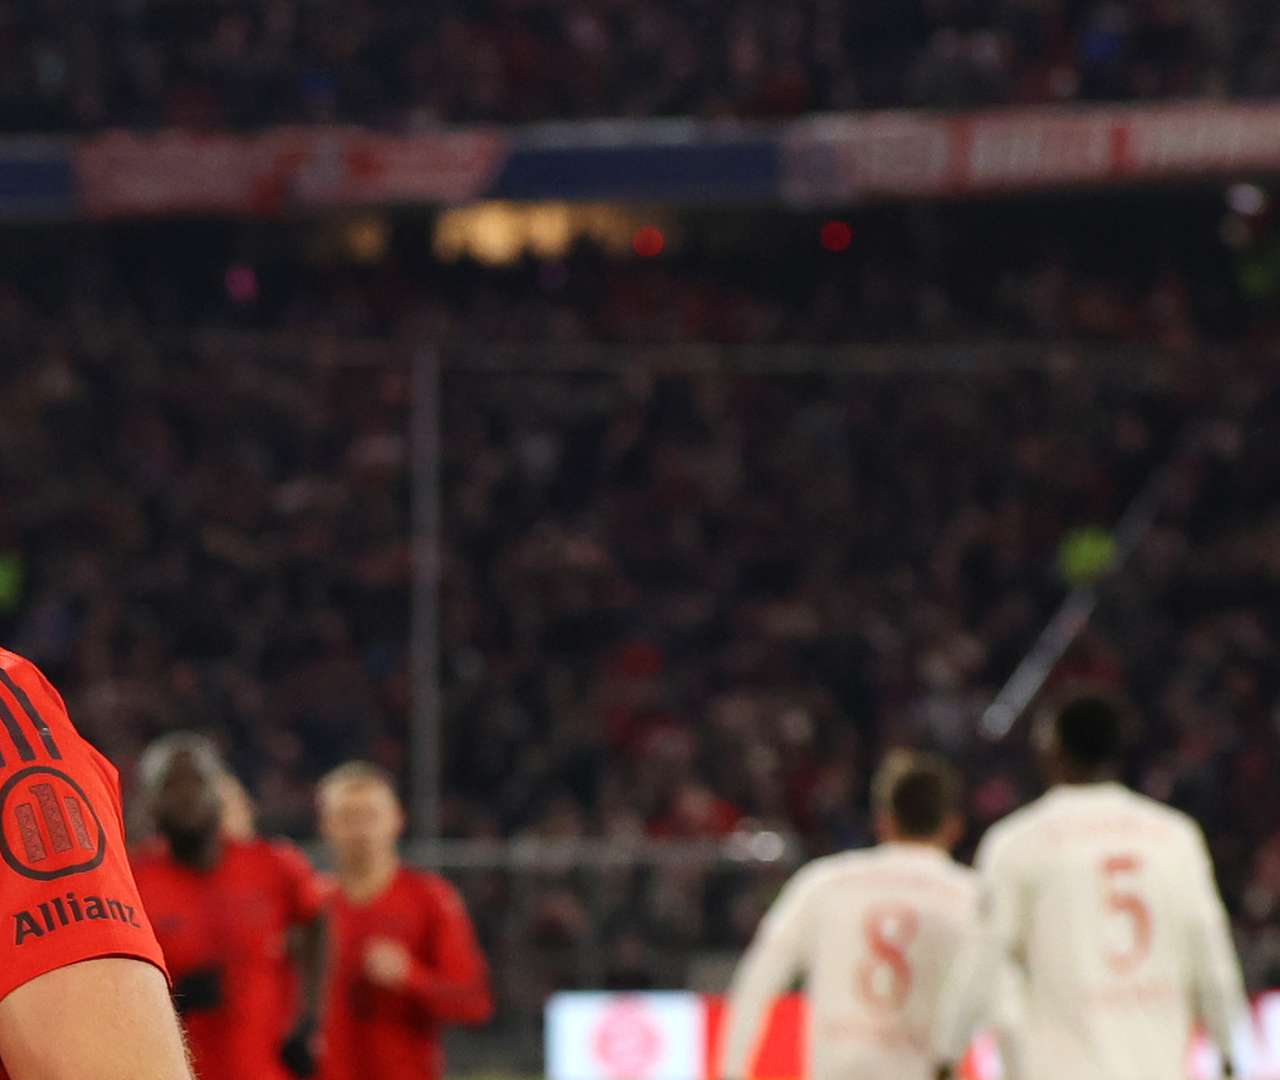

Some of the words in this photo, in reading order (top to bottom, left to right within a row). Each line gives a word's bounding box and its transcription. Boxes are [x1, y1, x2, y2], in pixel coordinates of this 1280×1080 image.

[12, 892, 141, 946] Allianz
[856, 899, 919, 1010] 8
[1101, 852, 1154, 977] 5
